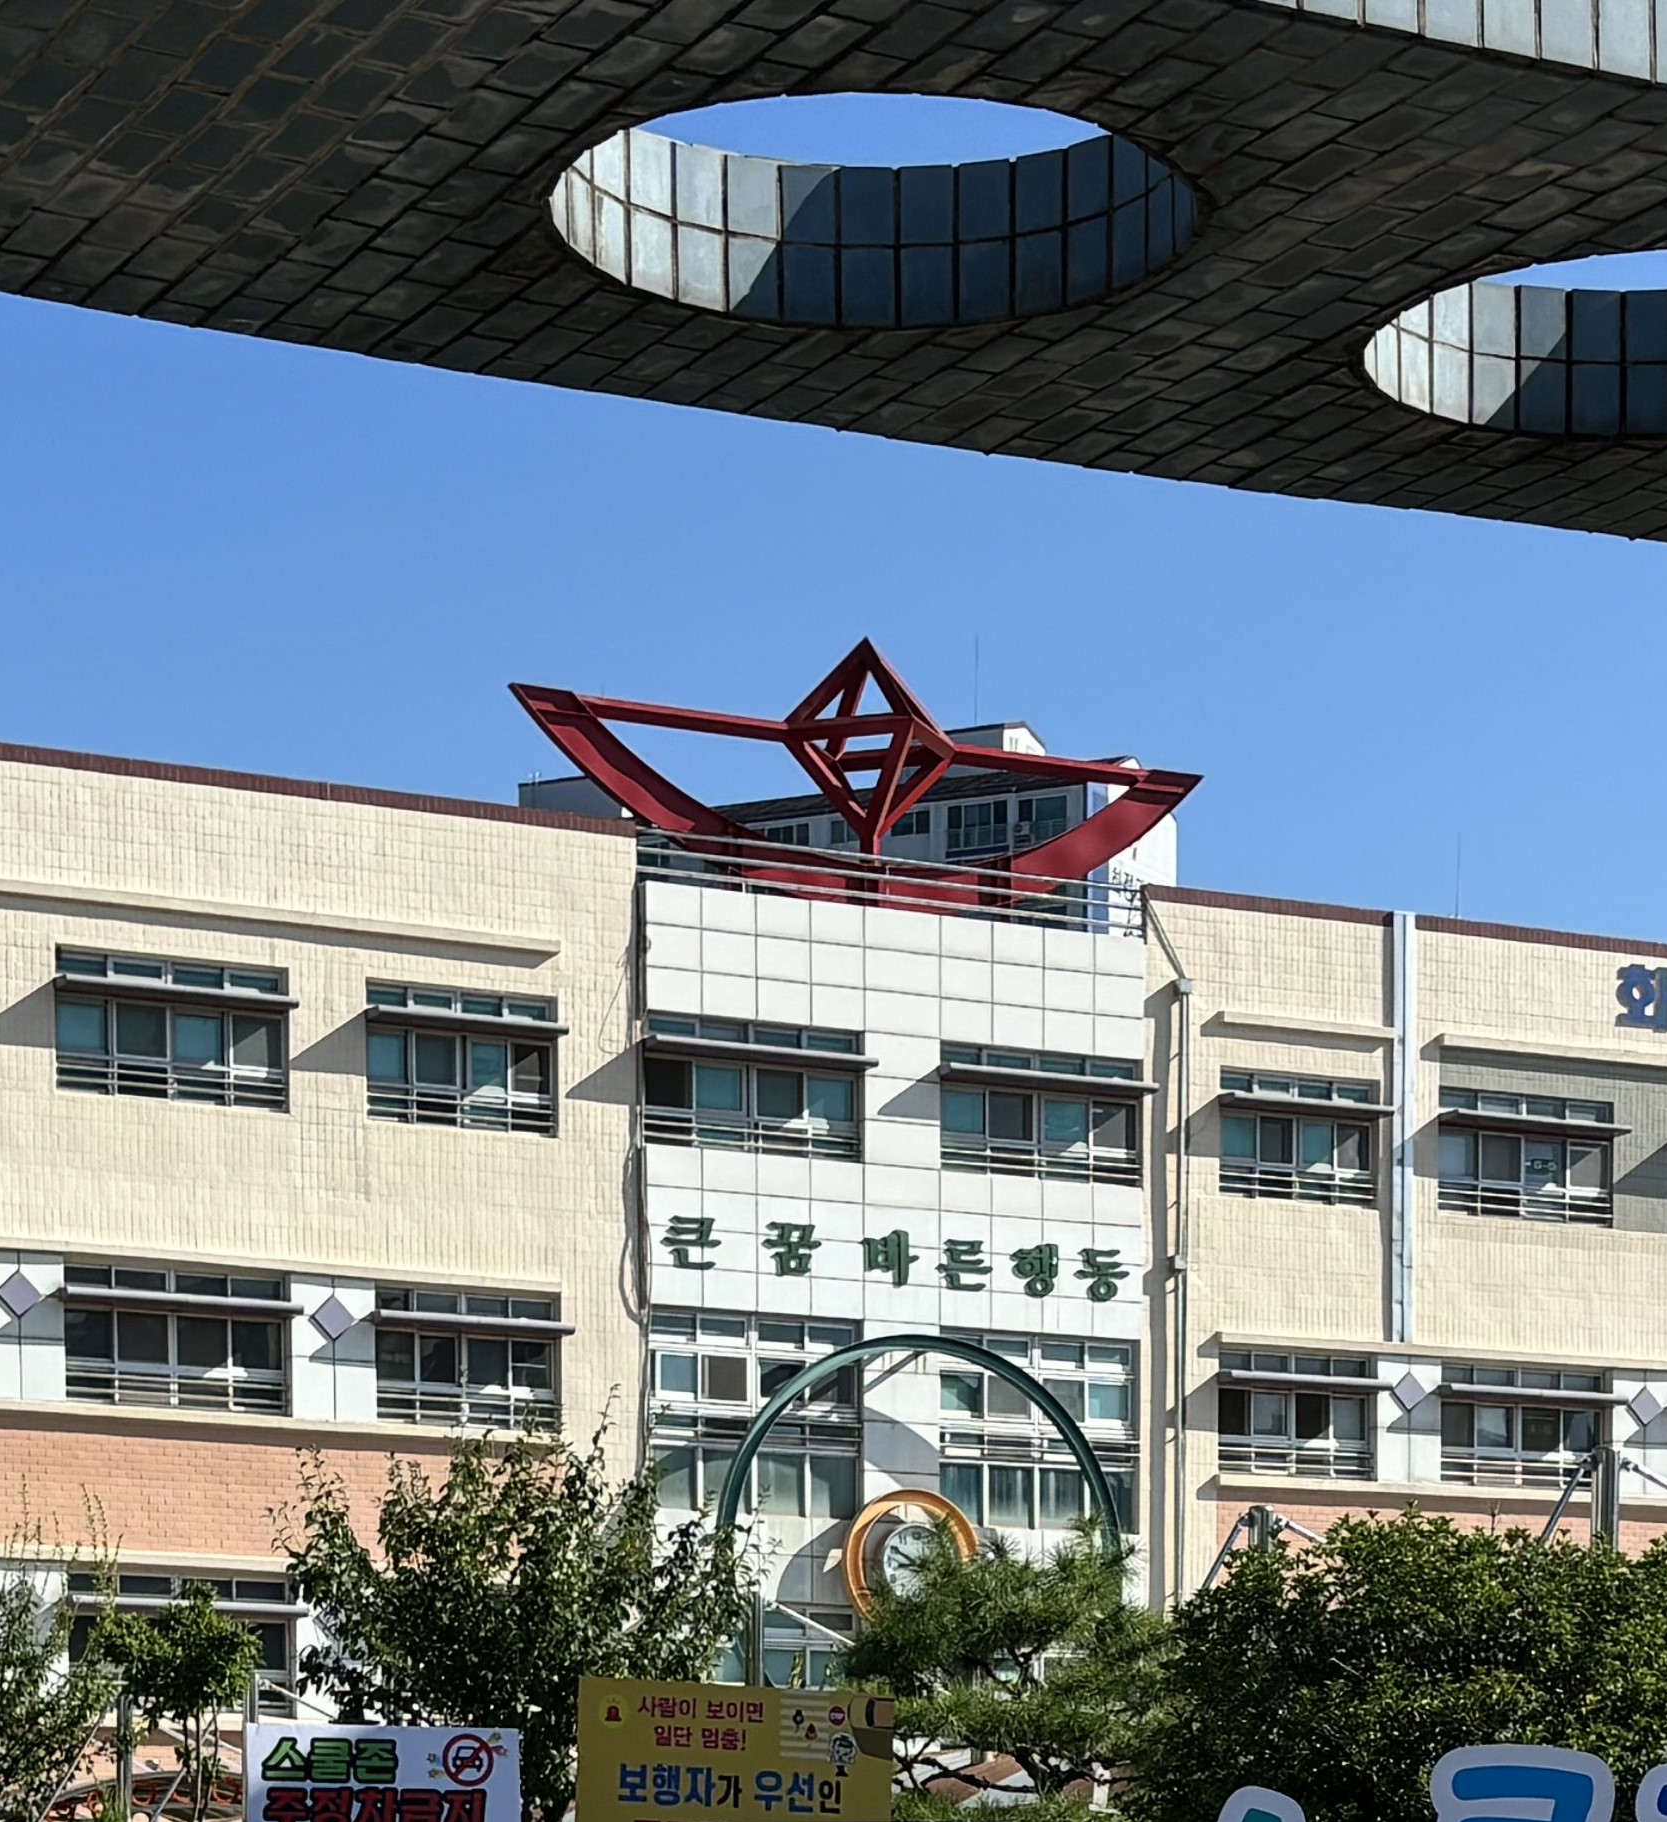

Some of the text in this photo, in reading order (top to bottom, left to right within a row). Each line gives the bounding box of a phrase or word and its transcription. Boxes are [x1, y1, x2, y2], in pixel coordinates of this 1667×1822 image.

[660, 1215, 1130, 1303] 큰 꿈 바른행동
[637, 1696, 764, 1723] 사람이 보이면
[261, 1737, 398, 1784] 스쿨존
[654, 1725, 747, 1751] 일단 멈춤!
[618, 1763, 841, 1814] 보행자가 우선인
